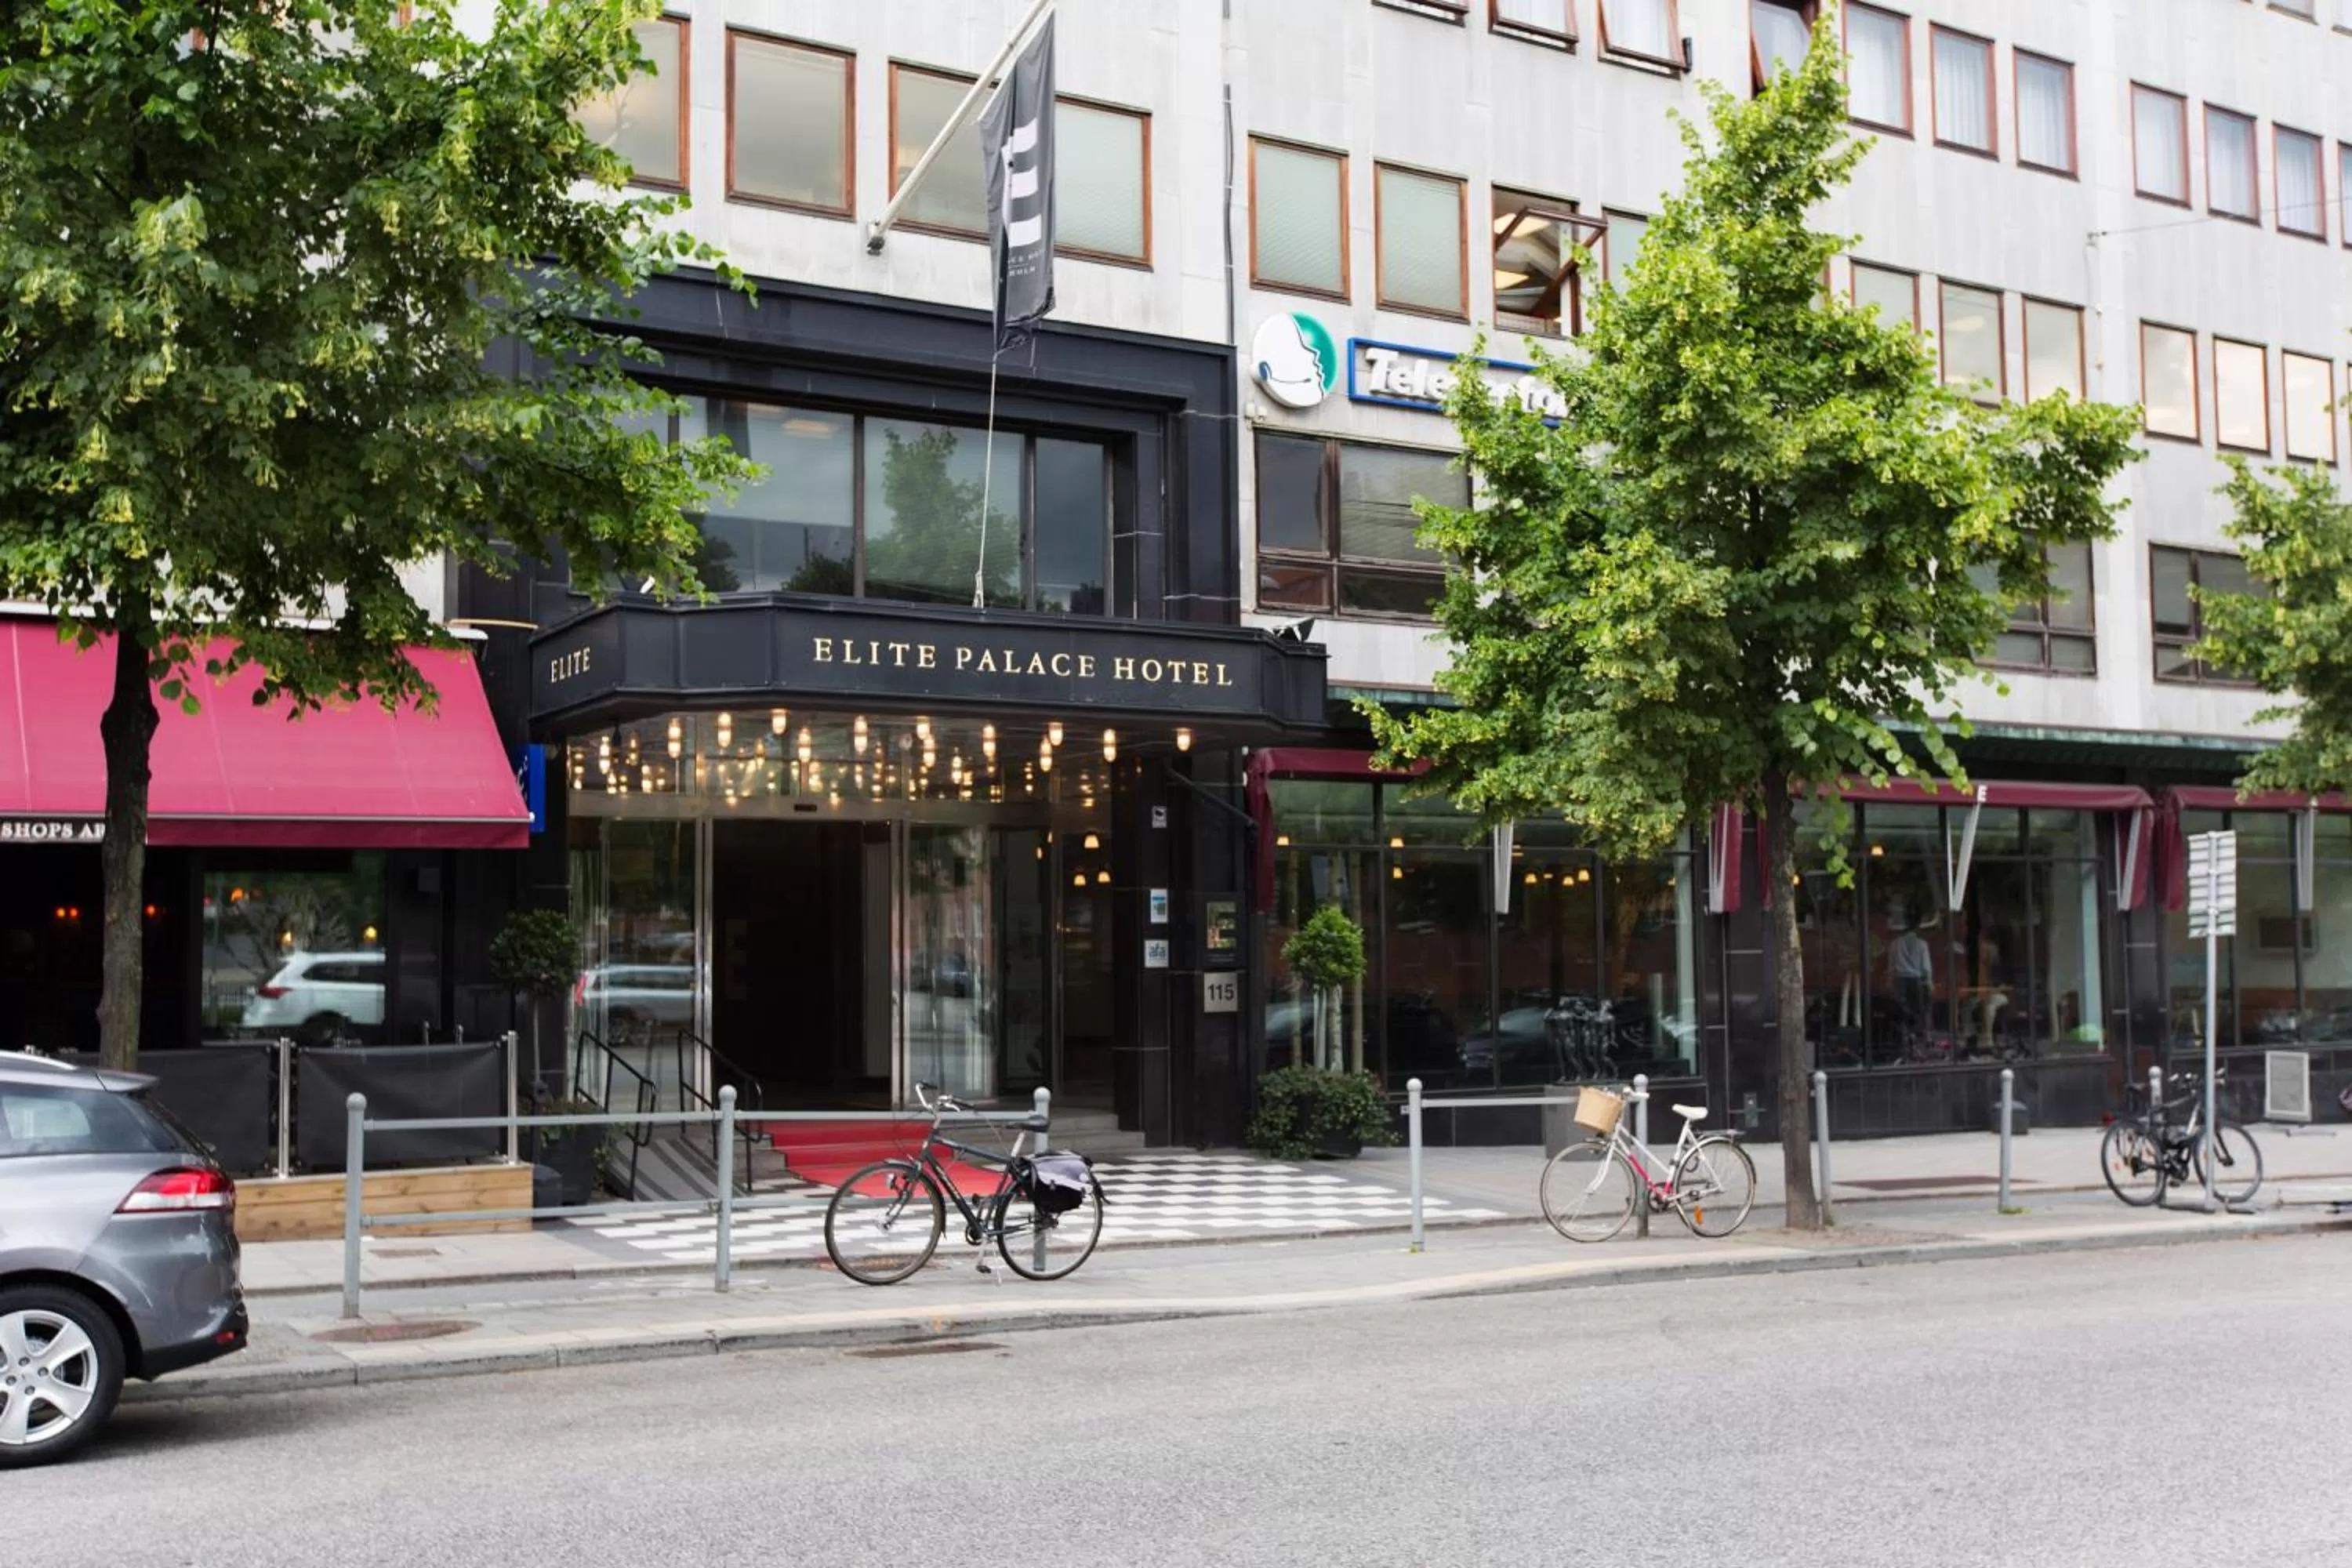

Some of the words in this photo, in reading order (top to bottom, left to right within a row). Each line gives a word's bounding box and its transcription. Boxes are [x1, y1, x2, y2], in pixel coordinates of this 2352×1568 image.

[551, 646, 590, 684] ELITE
[812, 637, 937, 668] ELITE
[955, 647, 1097, 678] PALACE
[1114, 658, 1234, 687] HOTEL
[1207, 983, 1234, 1001] 115
